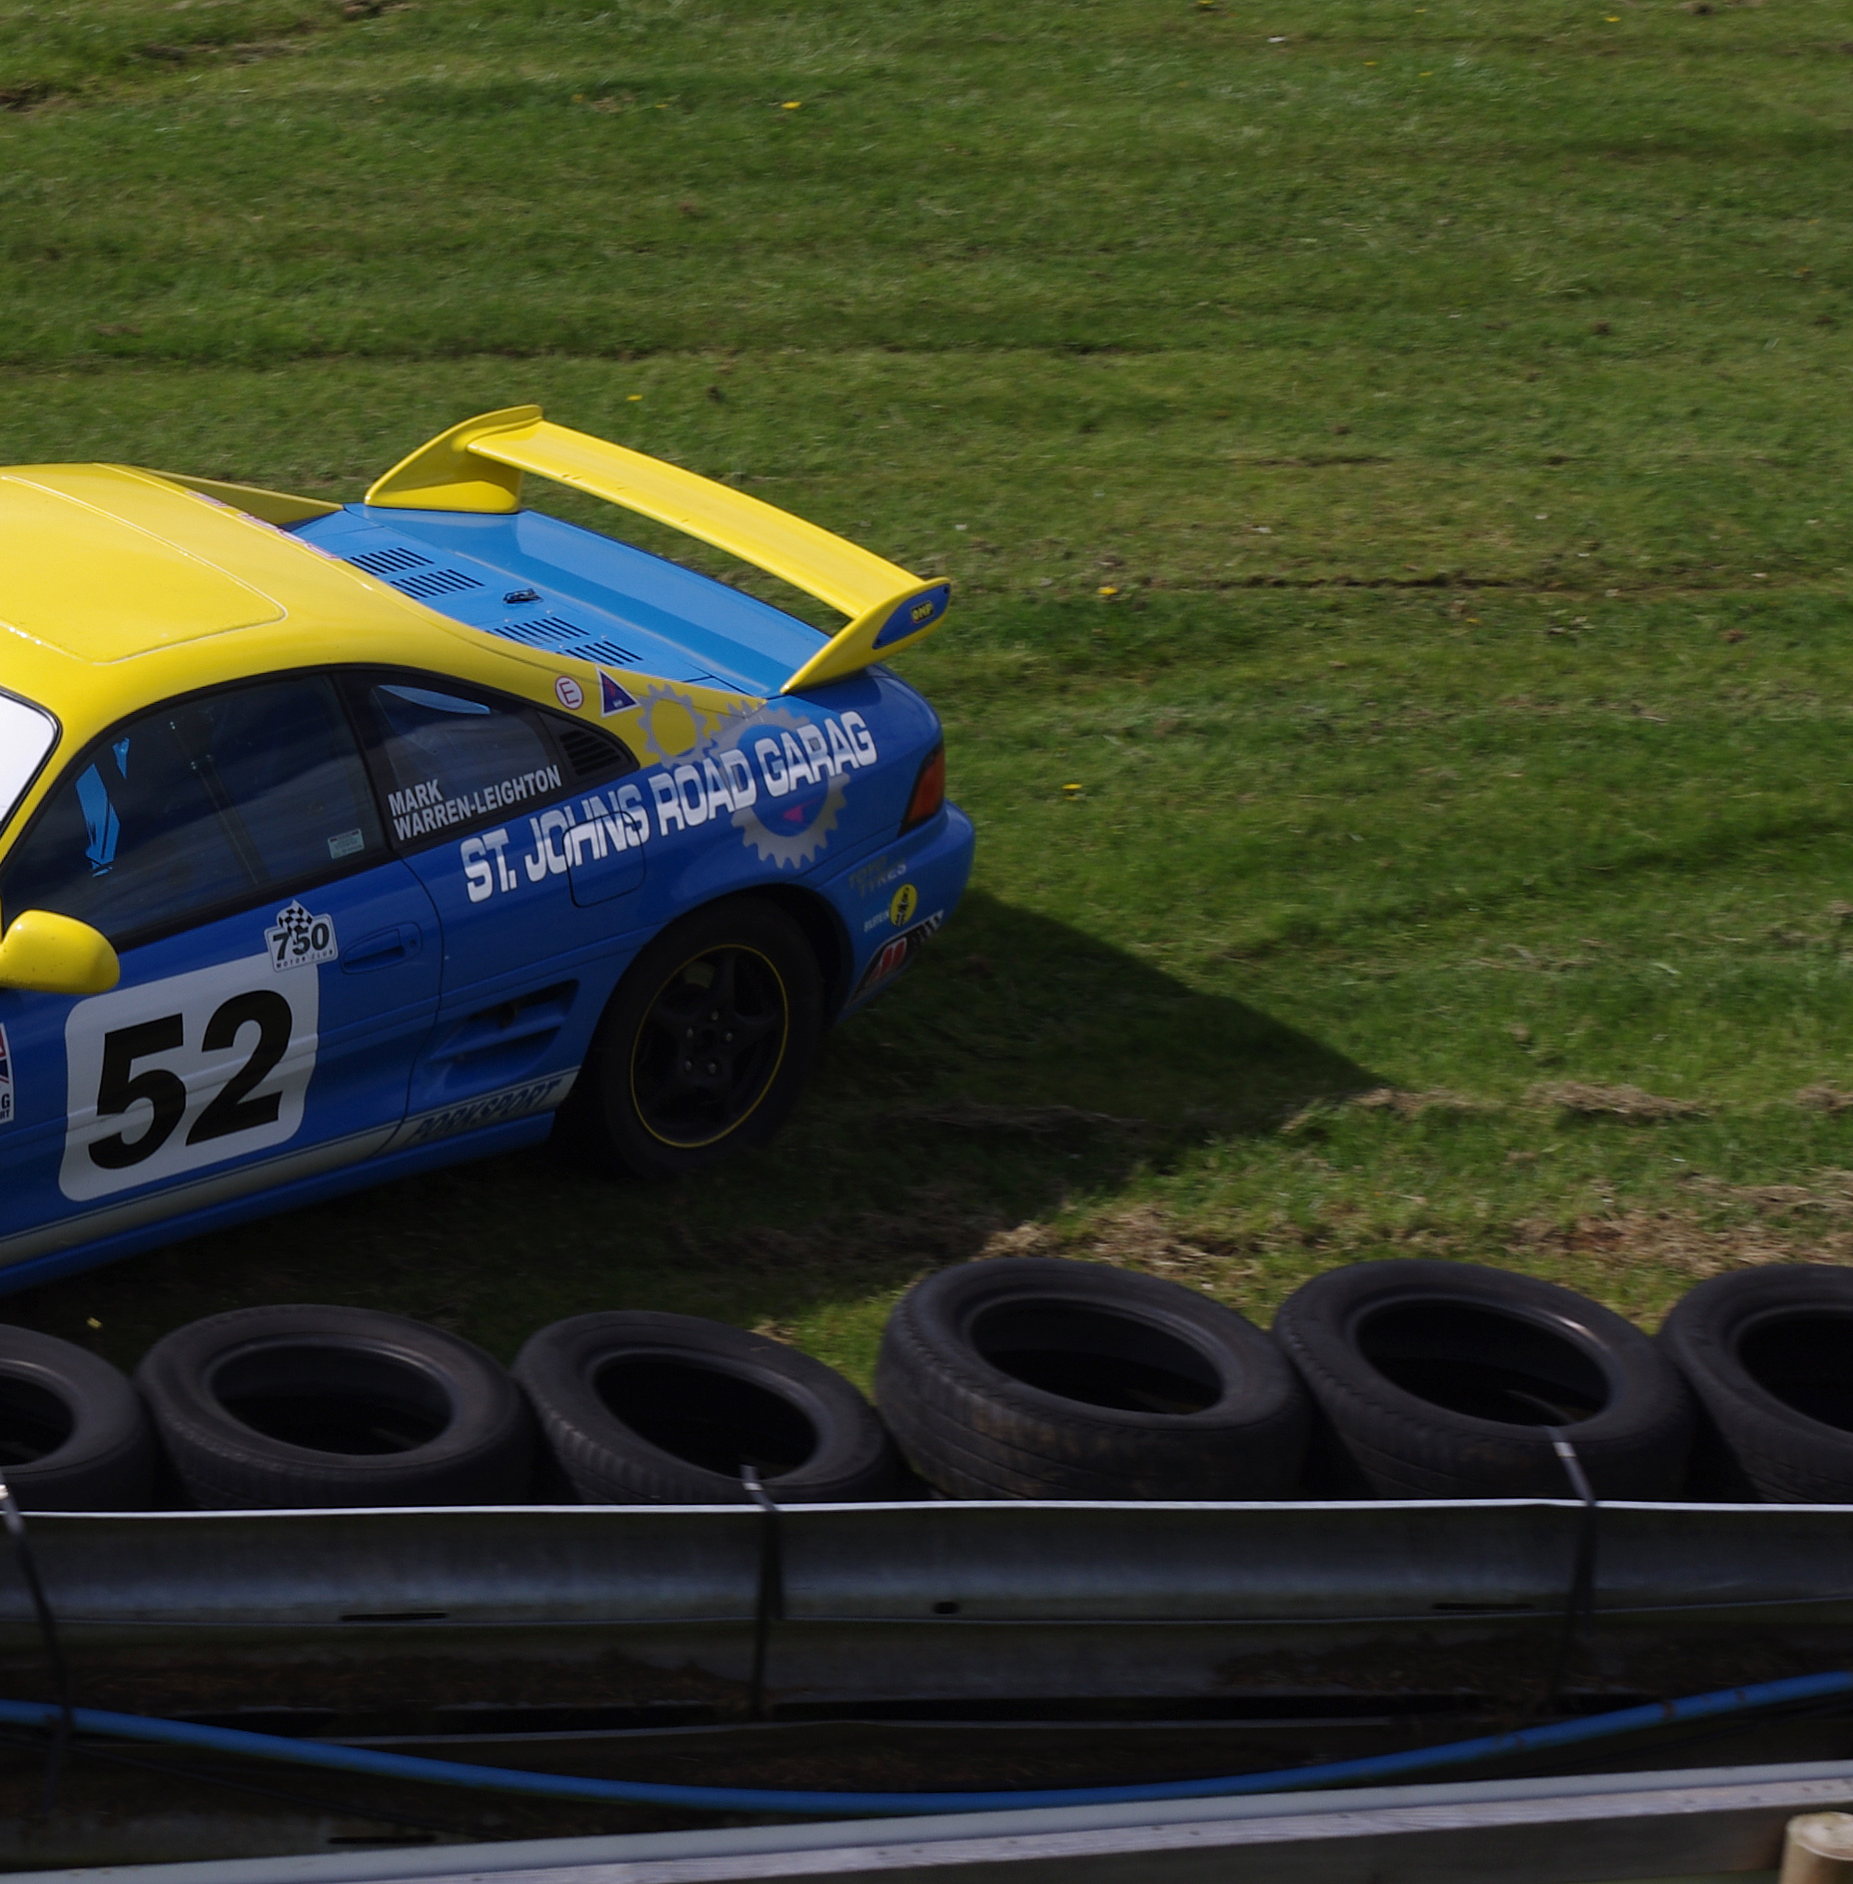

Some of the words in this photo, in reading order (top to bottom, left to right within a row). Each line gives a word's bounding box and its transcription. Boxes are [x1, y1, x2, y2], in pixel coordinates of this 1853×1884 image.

[559, 681, 581, 704] E
[387, 778, 444, 817] MARK
[393, 764, 562, 841] WARREN-LEIGHTON
[460, 827, 518, 903] ST.
[524, 783, 650, 883] JOHNS
[649, 746, 756, 837] ROAD
[754, 710, 878, 799] GARAG
[273, 922, 329, 961] 750
[276, 956, 306, 969] MOTOR
[311, 949, 333, 960] CLUB
[89, 989, 293, 1170] 52
